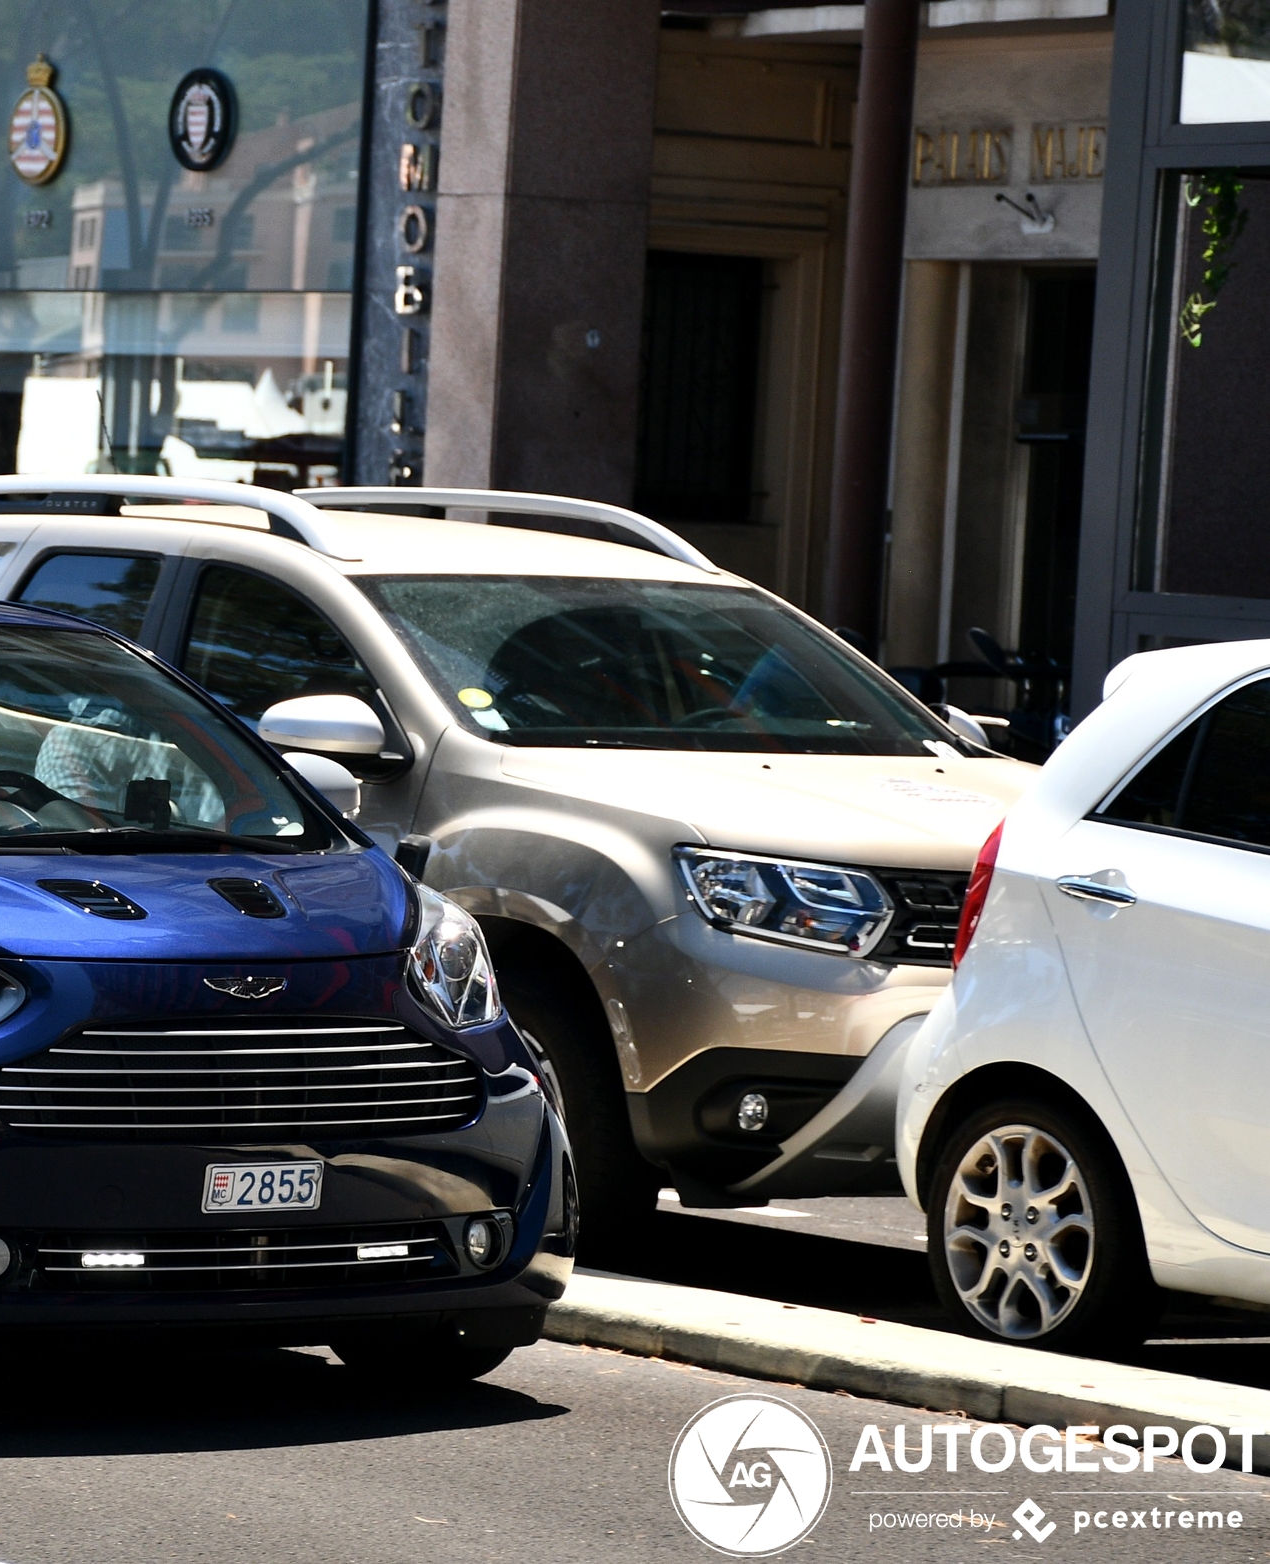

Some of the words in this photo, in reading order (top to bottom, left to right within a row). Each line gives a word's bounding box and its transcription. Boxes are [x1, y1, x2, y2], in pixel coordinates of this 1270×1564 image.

[915, 126, 1012, 183] PALAIS
[46, 500, 97, 508] DUSTER
[213, 1189, 227, 1199] MC
[237, 1169, 316, 1205] 2855
